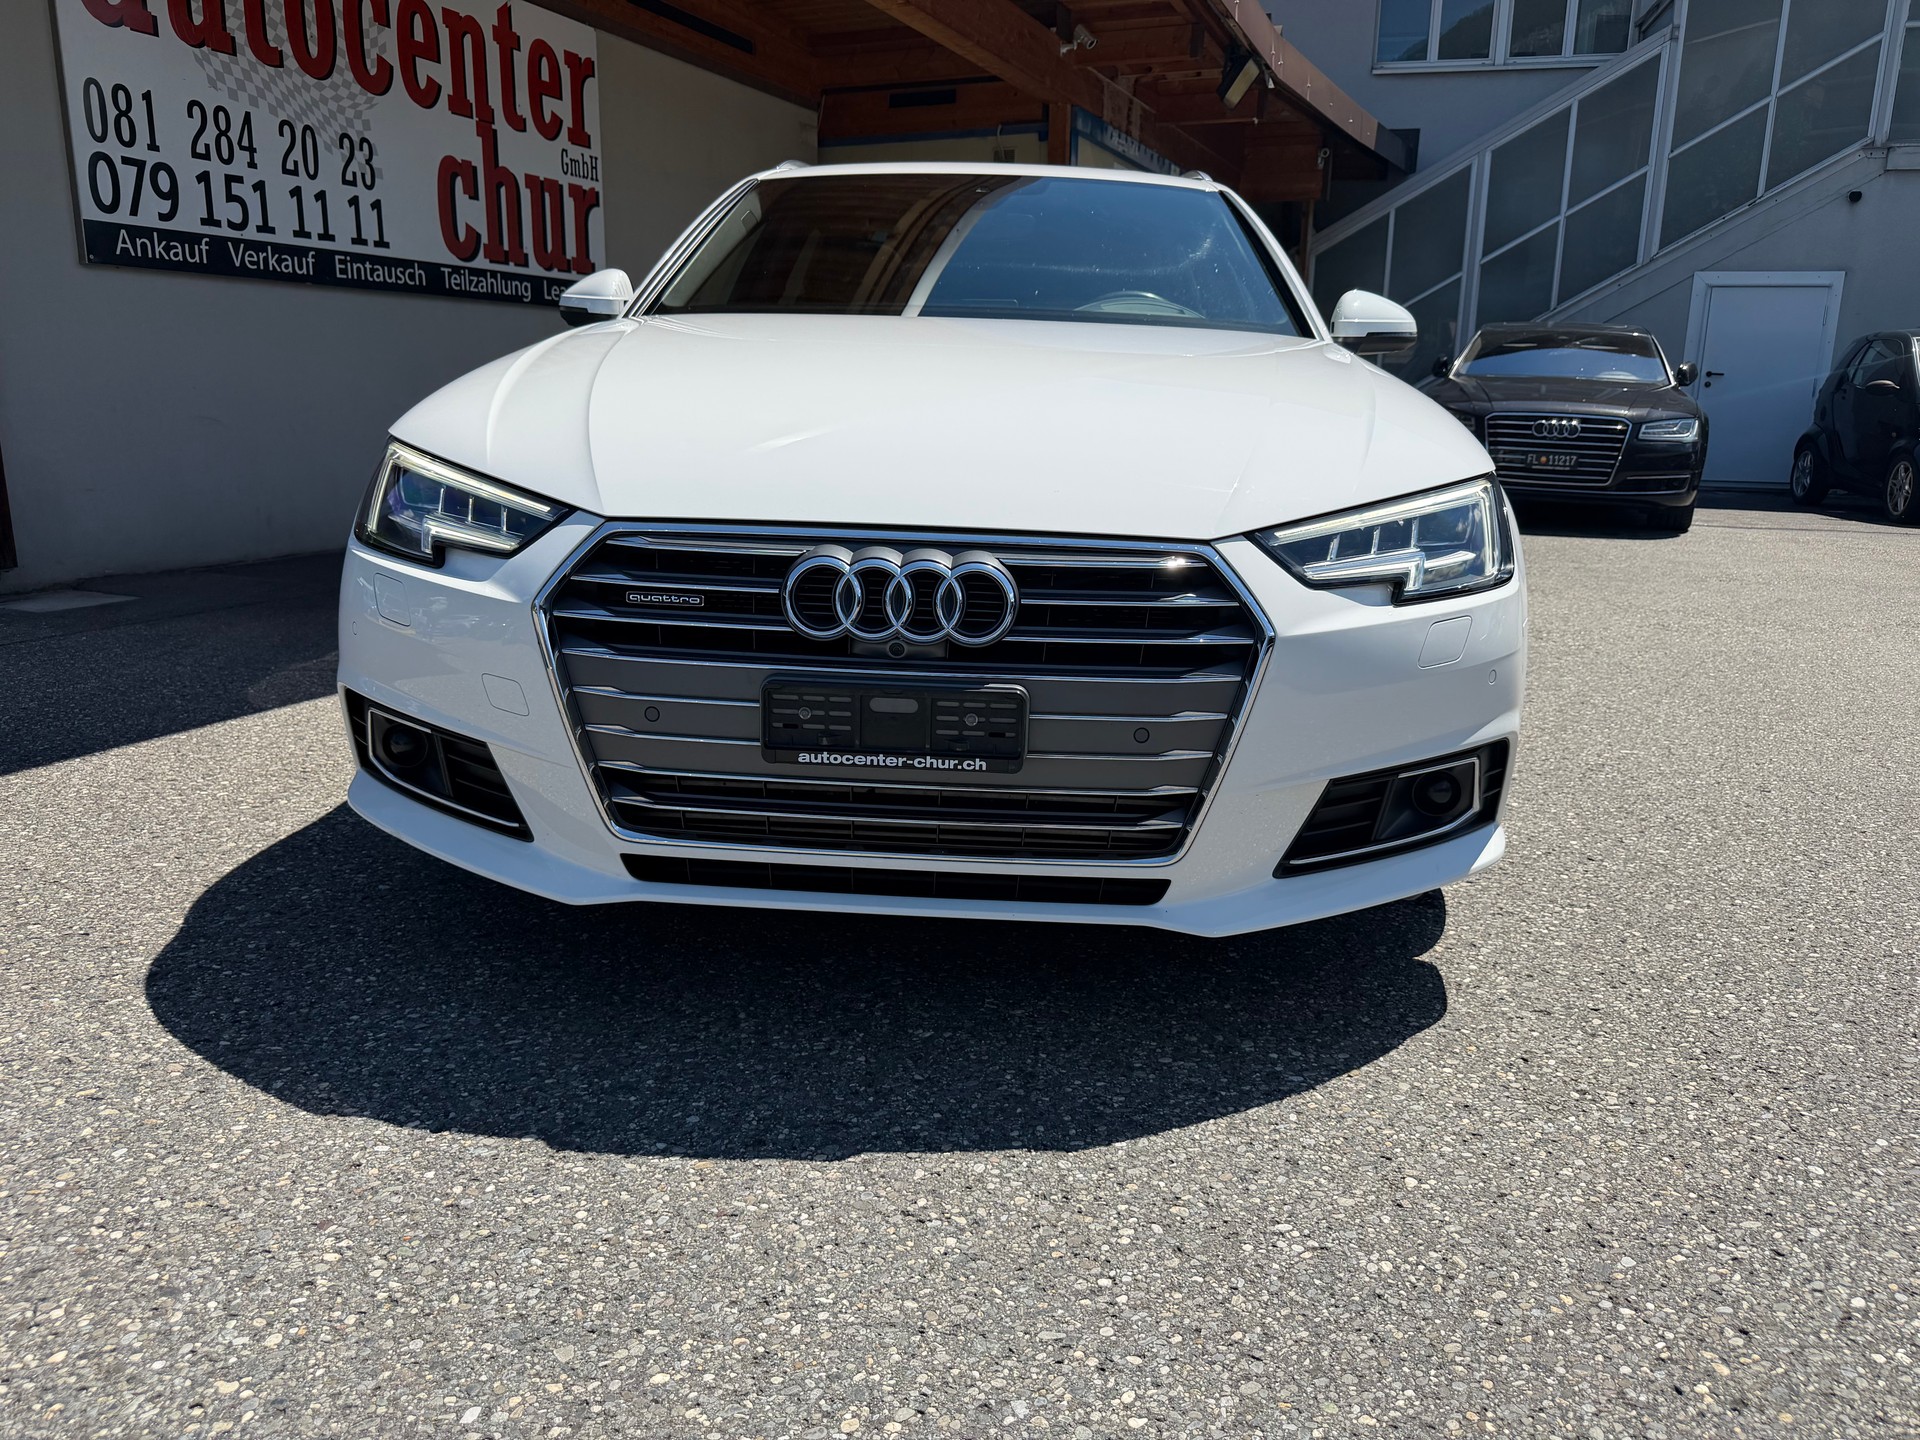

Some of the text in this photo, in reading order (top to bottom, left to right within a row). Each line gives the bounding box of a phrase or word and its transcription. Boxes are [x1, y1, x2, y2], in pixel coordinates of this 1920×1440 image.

[83, 77, 376, 190] 081 284 20 23
[561, 149, 599, 182] GmbH
[88, 151, 390, 249] 079 151 11 11
[437, 120, 599, 275] chur
[116, 229, 210, 264] Ankauf
[228, 242, 315, 276] Verkauf
[335, 255, 426, 286] Eintausch
[440, 268, 532, 302] Teilzahlung
[1527, 454, 1539, 464] FL
[629, 594, 700, 604] quattro
[798, 751, 987, 771] autocenter-chur.ch
